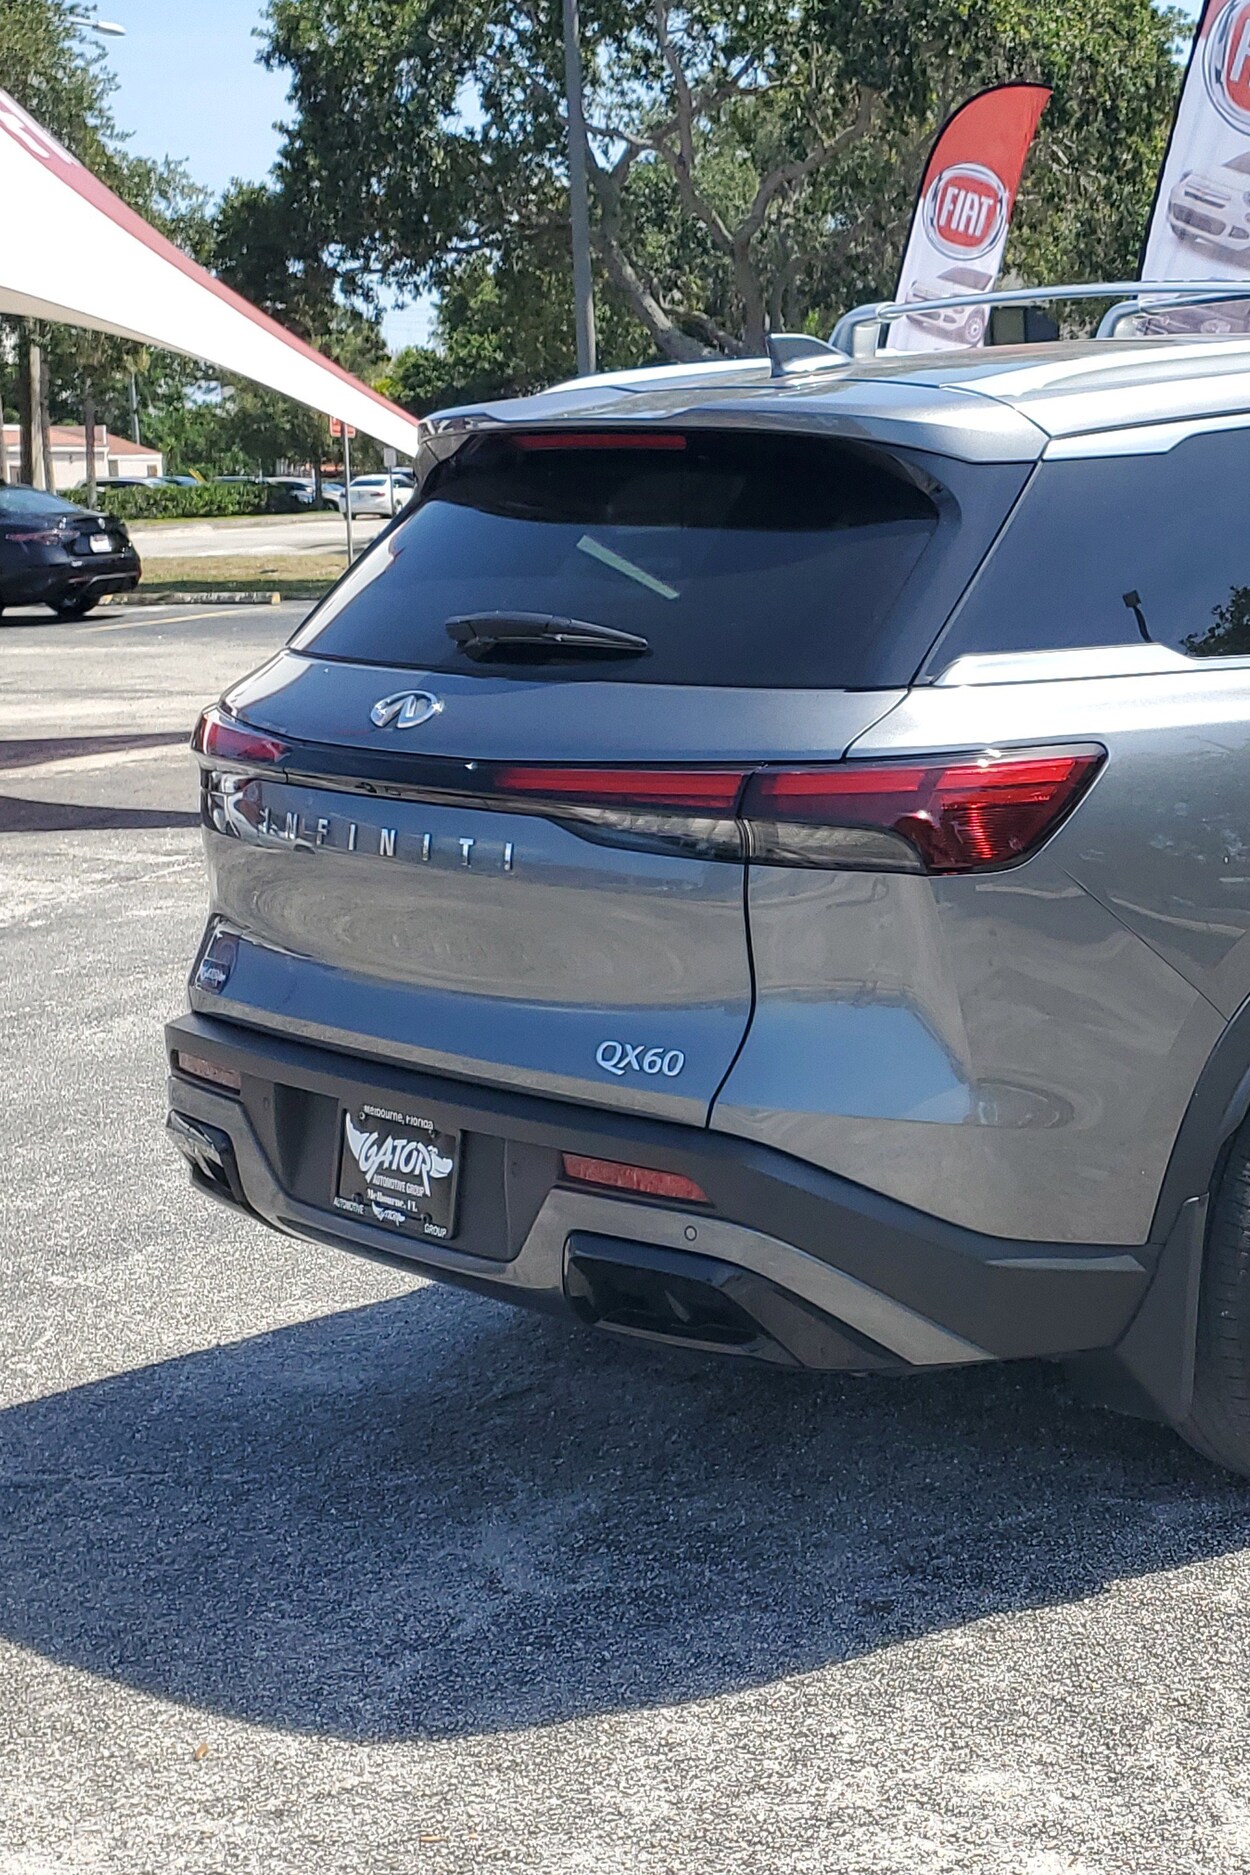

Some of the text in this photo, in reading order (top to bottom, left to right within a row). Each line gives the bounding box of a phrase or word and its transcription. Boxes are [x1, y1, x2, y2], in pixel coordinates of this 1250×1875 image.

[939, 186, 994, 237] FIAT
[257, 807, 515, 872] INFINITI
[596, 1040, 685, 1076] QX60
[359, 1131, 431, 1197] GATOR
[424, 1223, 447, 1236] GROUP
